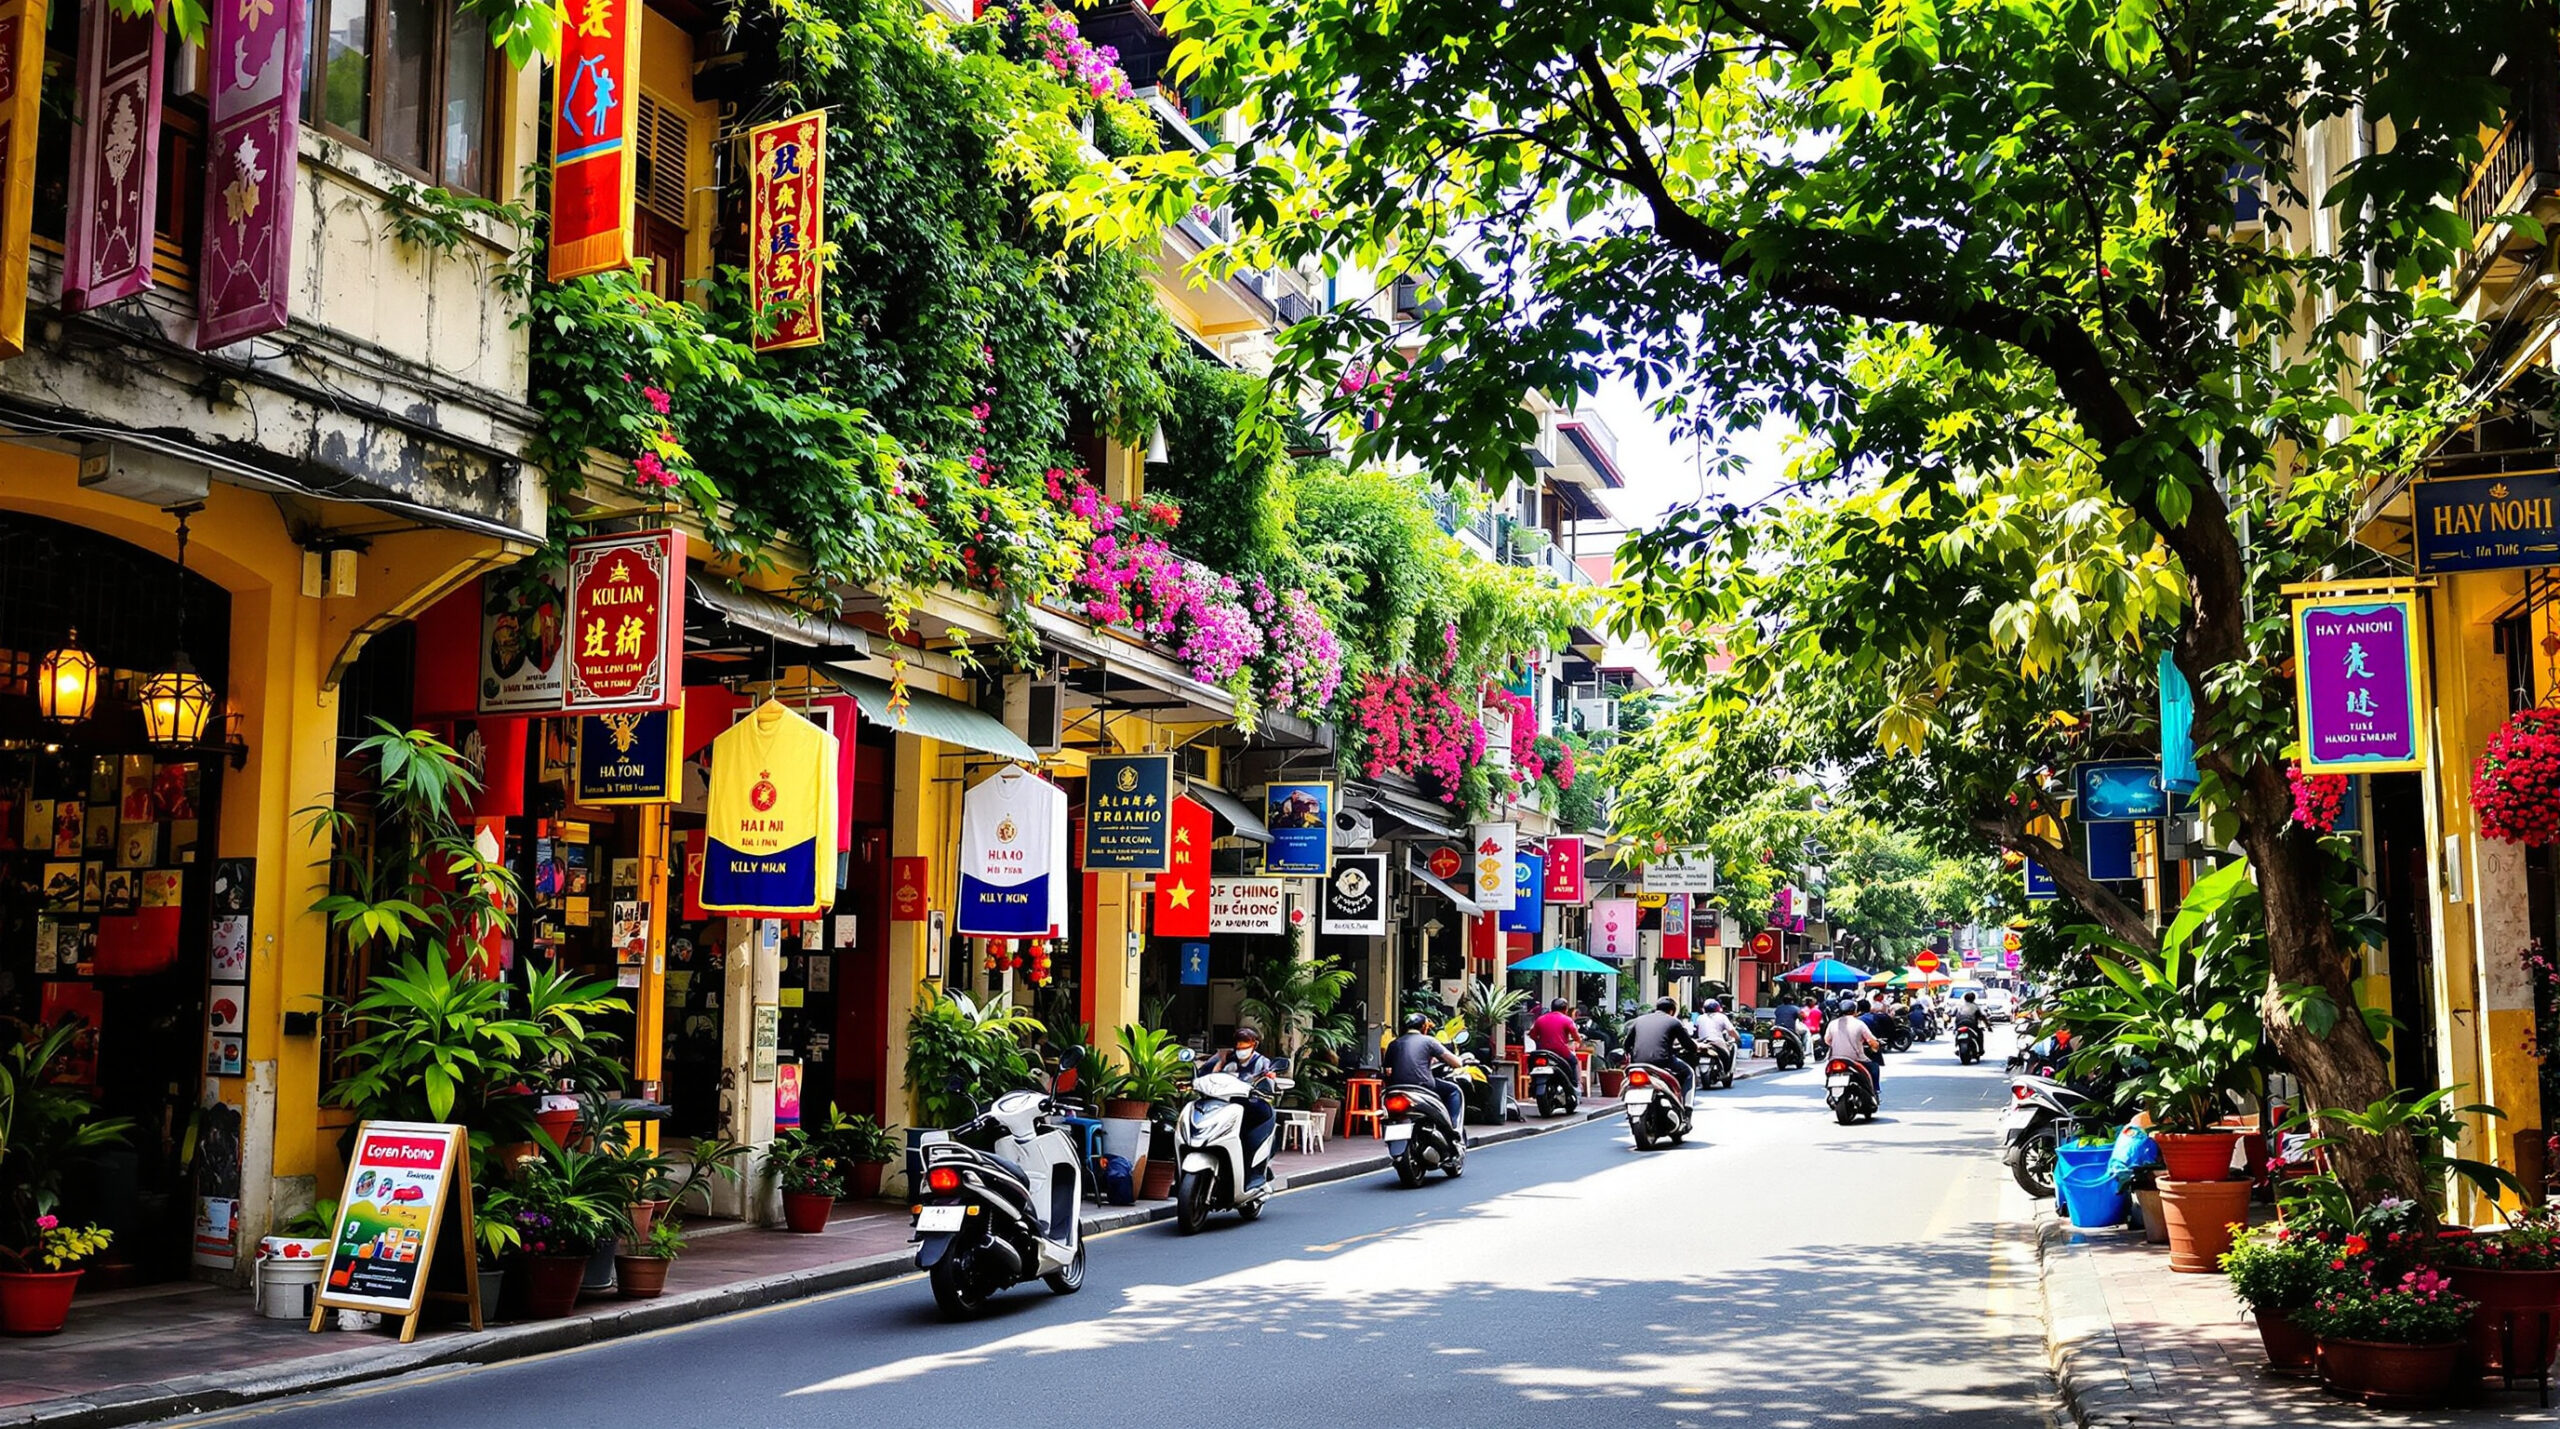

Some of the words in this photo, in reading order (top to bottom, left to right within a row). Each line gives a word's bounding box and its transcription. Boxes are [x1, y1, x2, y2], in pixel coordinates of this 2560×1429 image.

[2434, 505, 2484, 535] HAY
[2490, 498, 2553, 532] NOHI
[592, 585, 644, 606] KOLIAN
[2316, 624, 2342, 636] HAY
